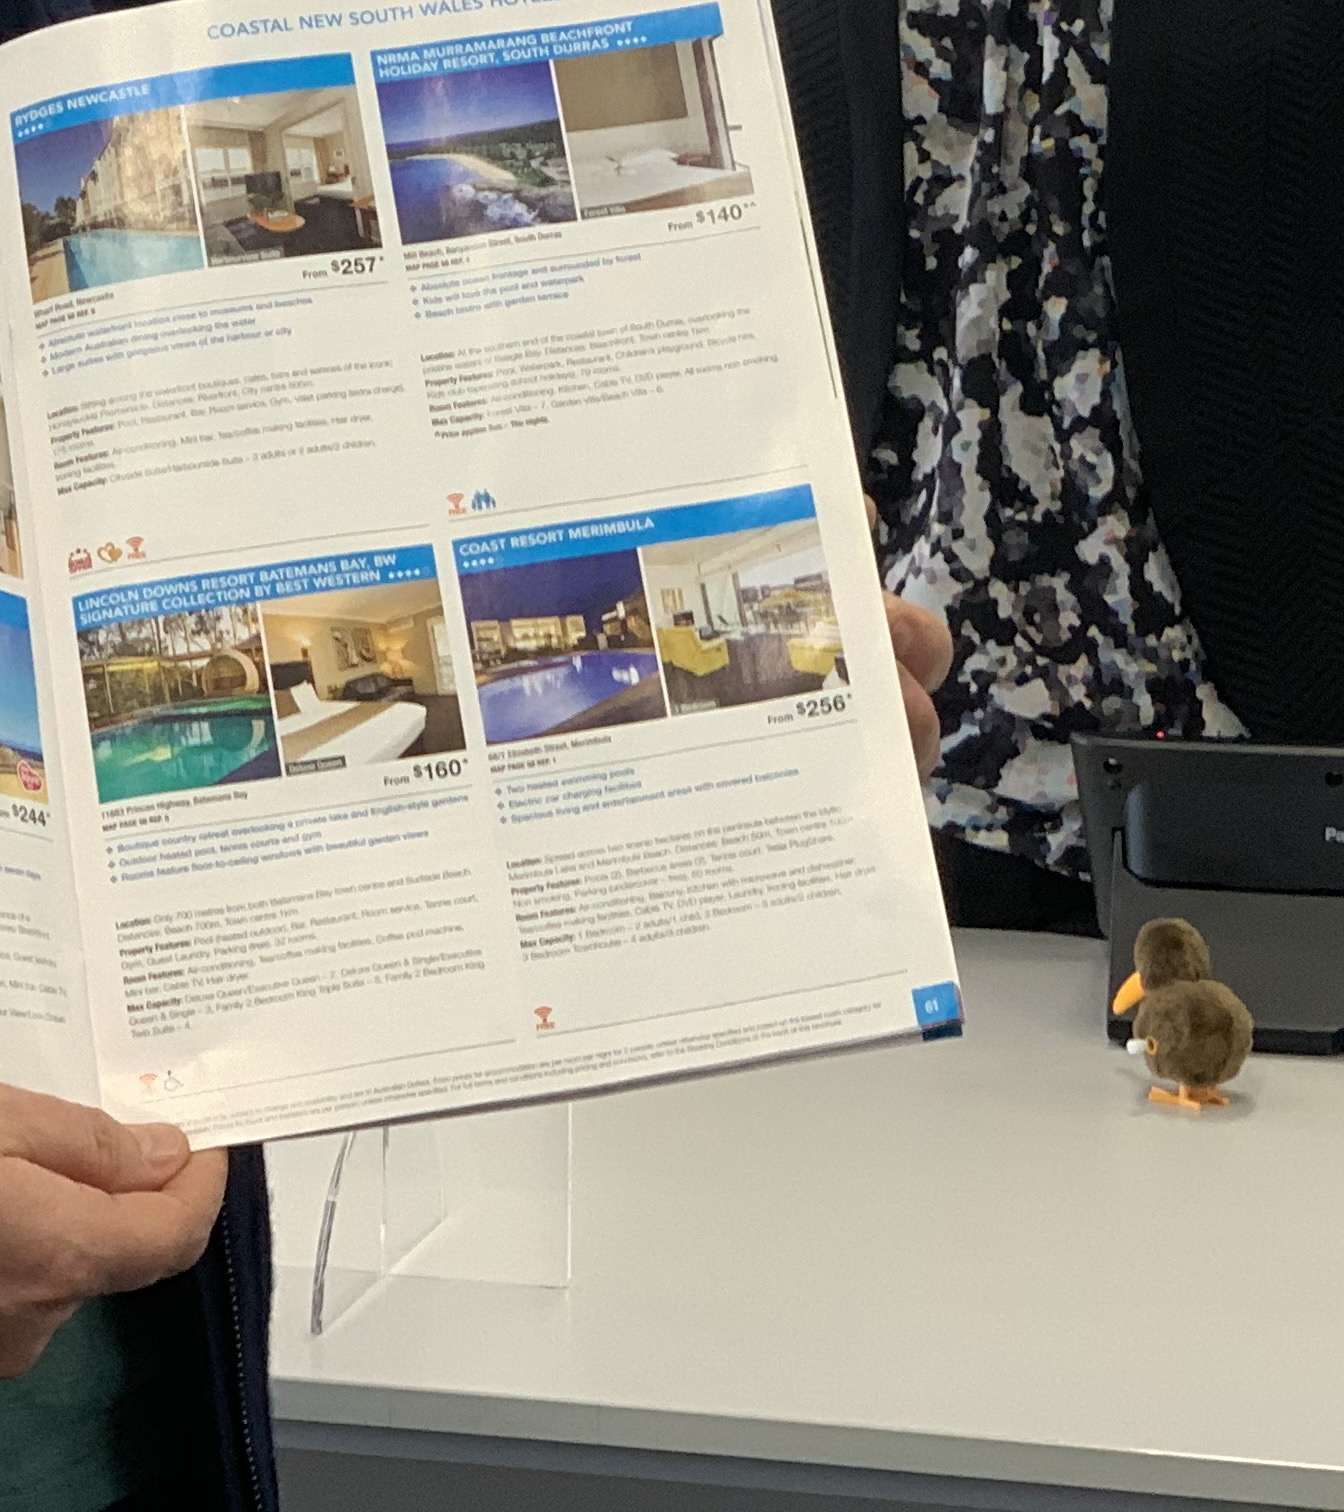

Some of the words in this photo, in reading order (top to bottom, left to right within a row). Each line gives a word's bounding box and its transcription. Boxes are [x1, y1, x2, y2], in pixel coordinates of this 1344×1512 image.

[207, 17, 294, 40] COASTAL
[298, 12, 343, 30] NEW
[349, 4, 414, 26] SOUTH
[376, 51, 419, 65] NRMA
[423, 32, 539, 60] MURRAMARANG
[540, 21, 633, 44] BEACHFRONT
[378, 63, 440, 79] HOLIDAY
[443, 52, 500, 71] RESORT,
[502, 45, 550, 62] SOUTH
[553, 39, 610, 55] DURRAS
[14, 101, 64, 128] RYDGES
[67, 84, 150, 110] NEWCASTLE
[667, 219, 694, 233] From
[302, 268, 328, 280] From
[459, 537, 508, 557] COAST
[510, 529, 565, 550] RESORT
[568, 516, 655, 542] MERIMBULA
[78, 588, 140, 613] LINCOLN
[144, 580, 198, 599] DOWNS
[202, 572, 256, 590] RESORT
[259, 561, 337, 584] BATEMANS
[340, 558, 371, 572] BAY,
[374, 553, 397, 567] BW
[79, 600, 158, 627] SIGNATURE
[162, 584, 252, 610] COLLECTION
[255, 582, 272, 597] BY
[275, 577, 310, 594] BEST
[313, 570, 381, 588] WESTERN
[766, 711, 794, 726] From
[383, 773, 411, 788] From
